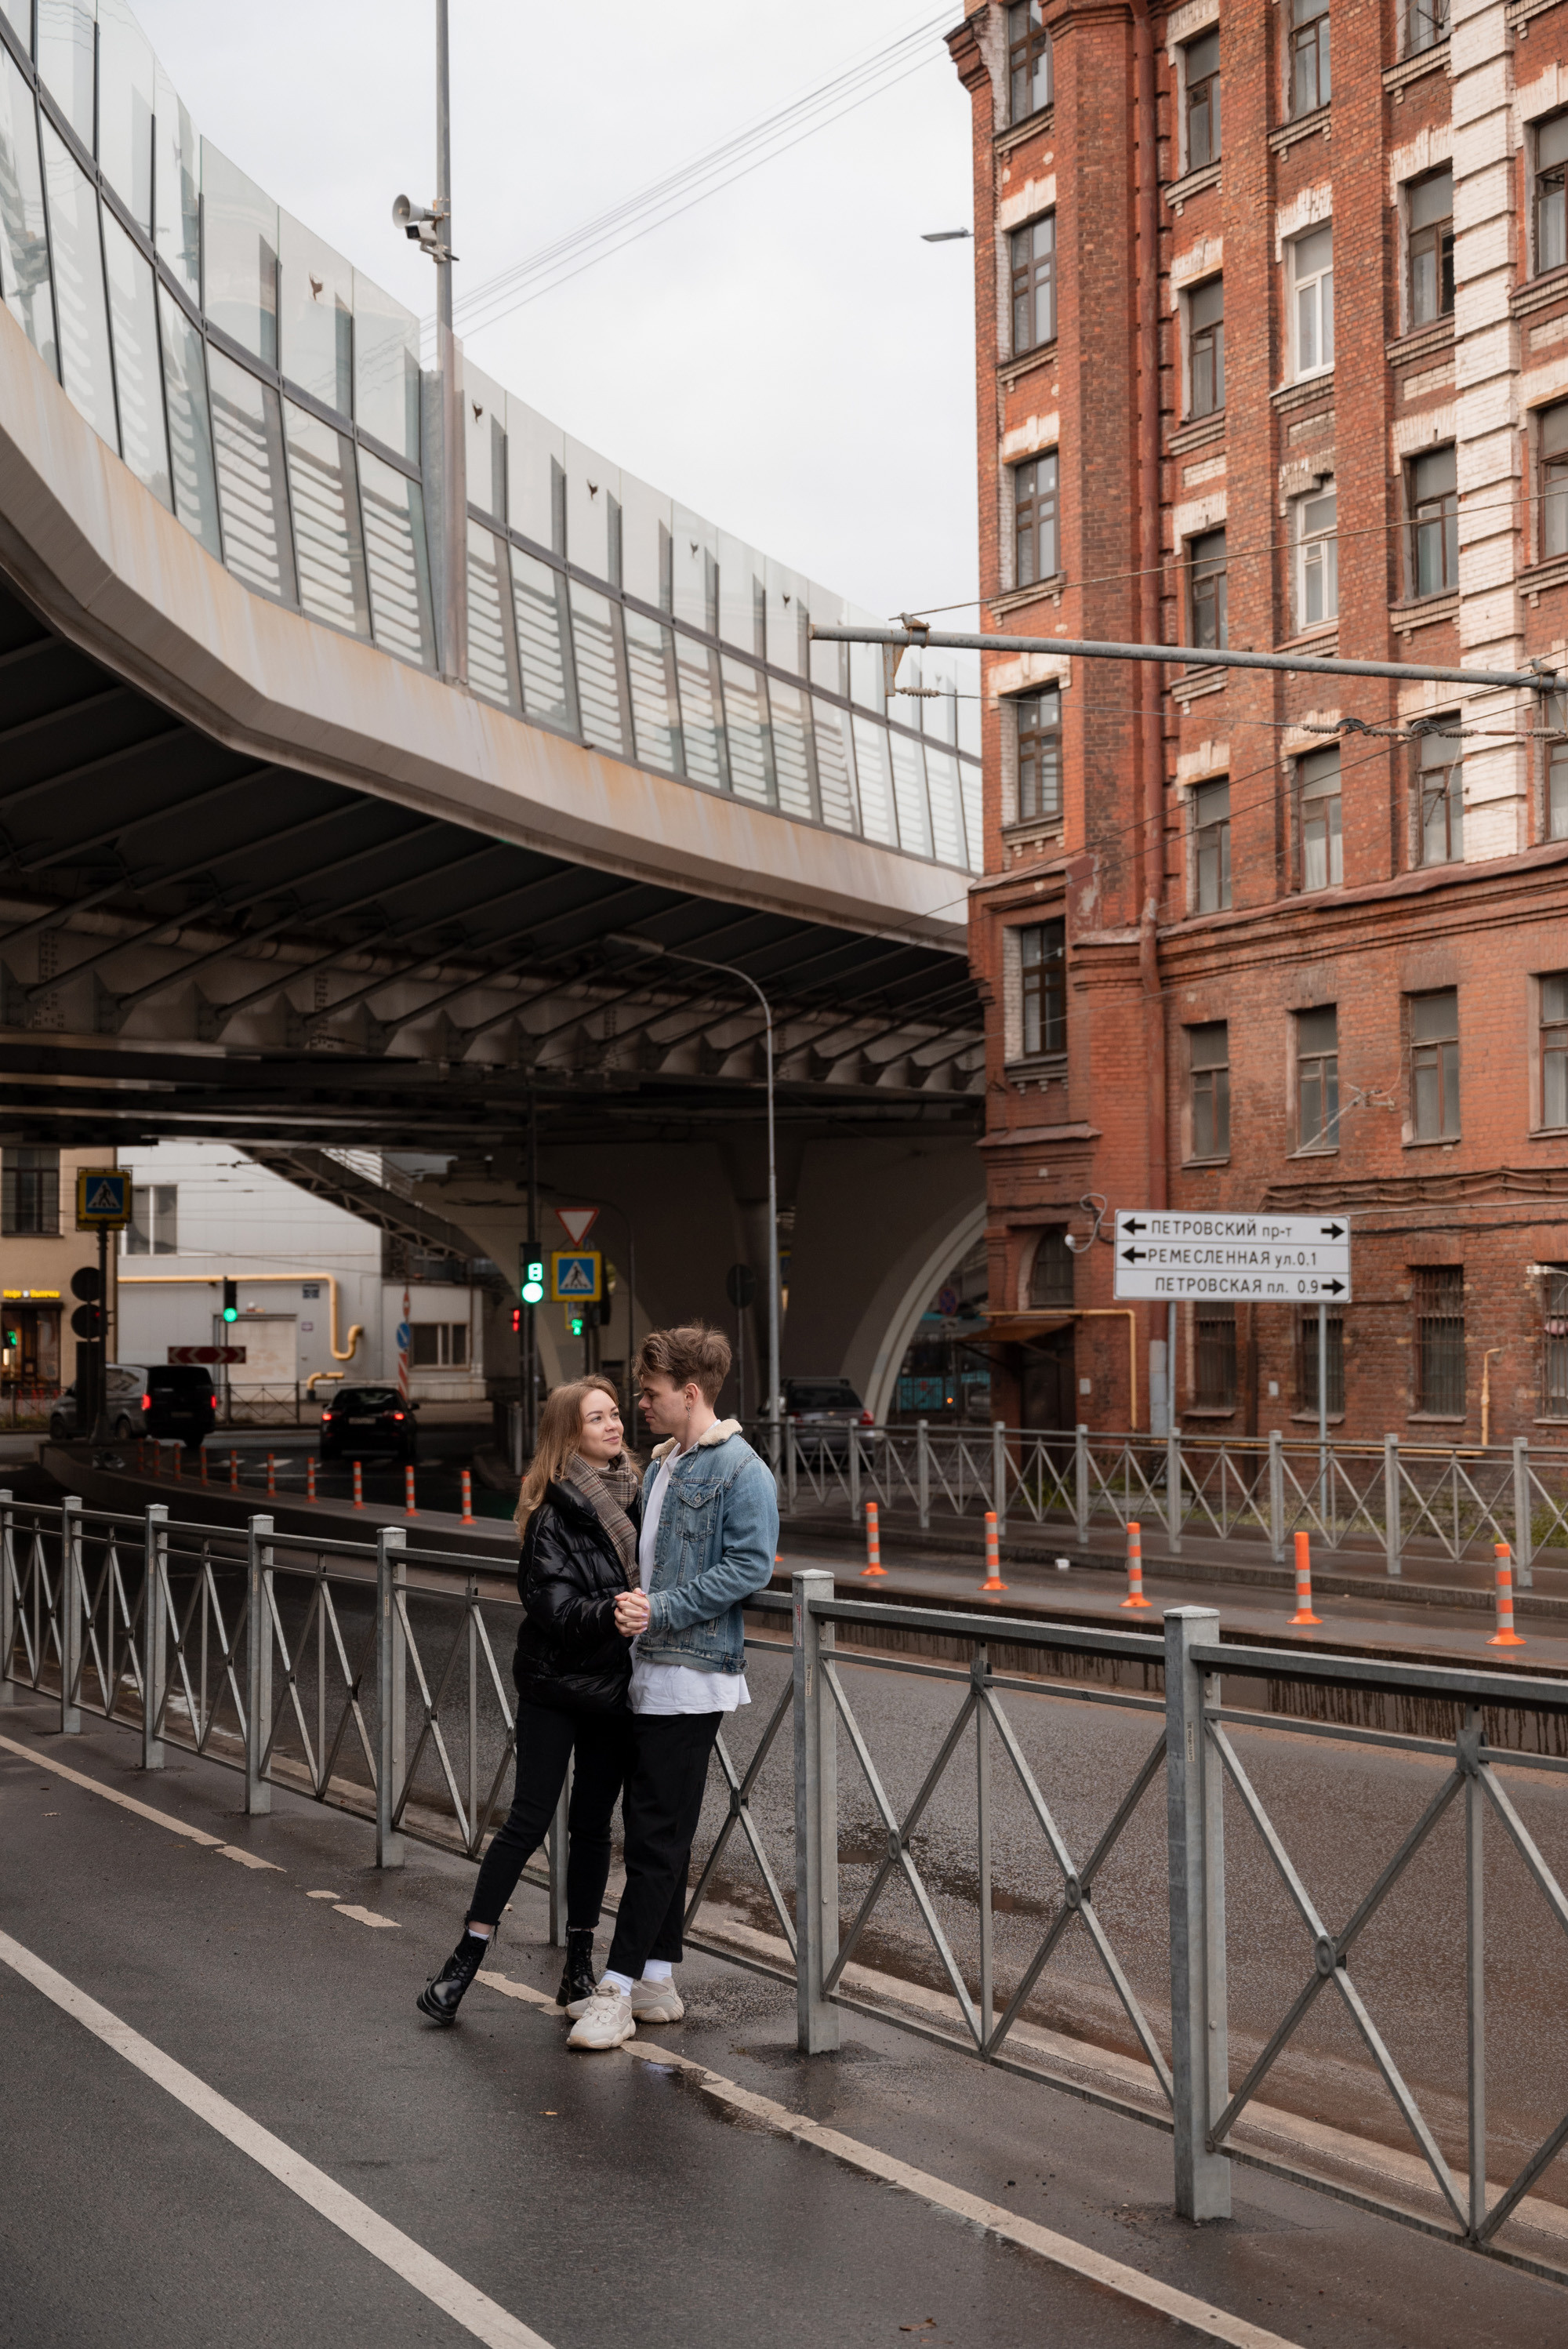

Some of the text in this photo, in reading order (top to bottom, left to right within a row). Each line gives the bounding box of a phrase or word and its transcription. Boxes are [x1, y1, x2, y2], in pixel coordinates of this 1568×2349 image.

[1152, 1219, 1292, 1240] ПЕТРОВСКИЙ пр-т
[1149, 1248, 1270, 1265] РЕМЕСЛЕННАЯ
[1155, 1276, 1261, 1293] ПЕТРОВСКАЯ
[1266, 1283, 1289, 1293] пл.
